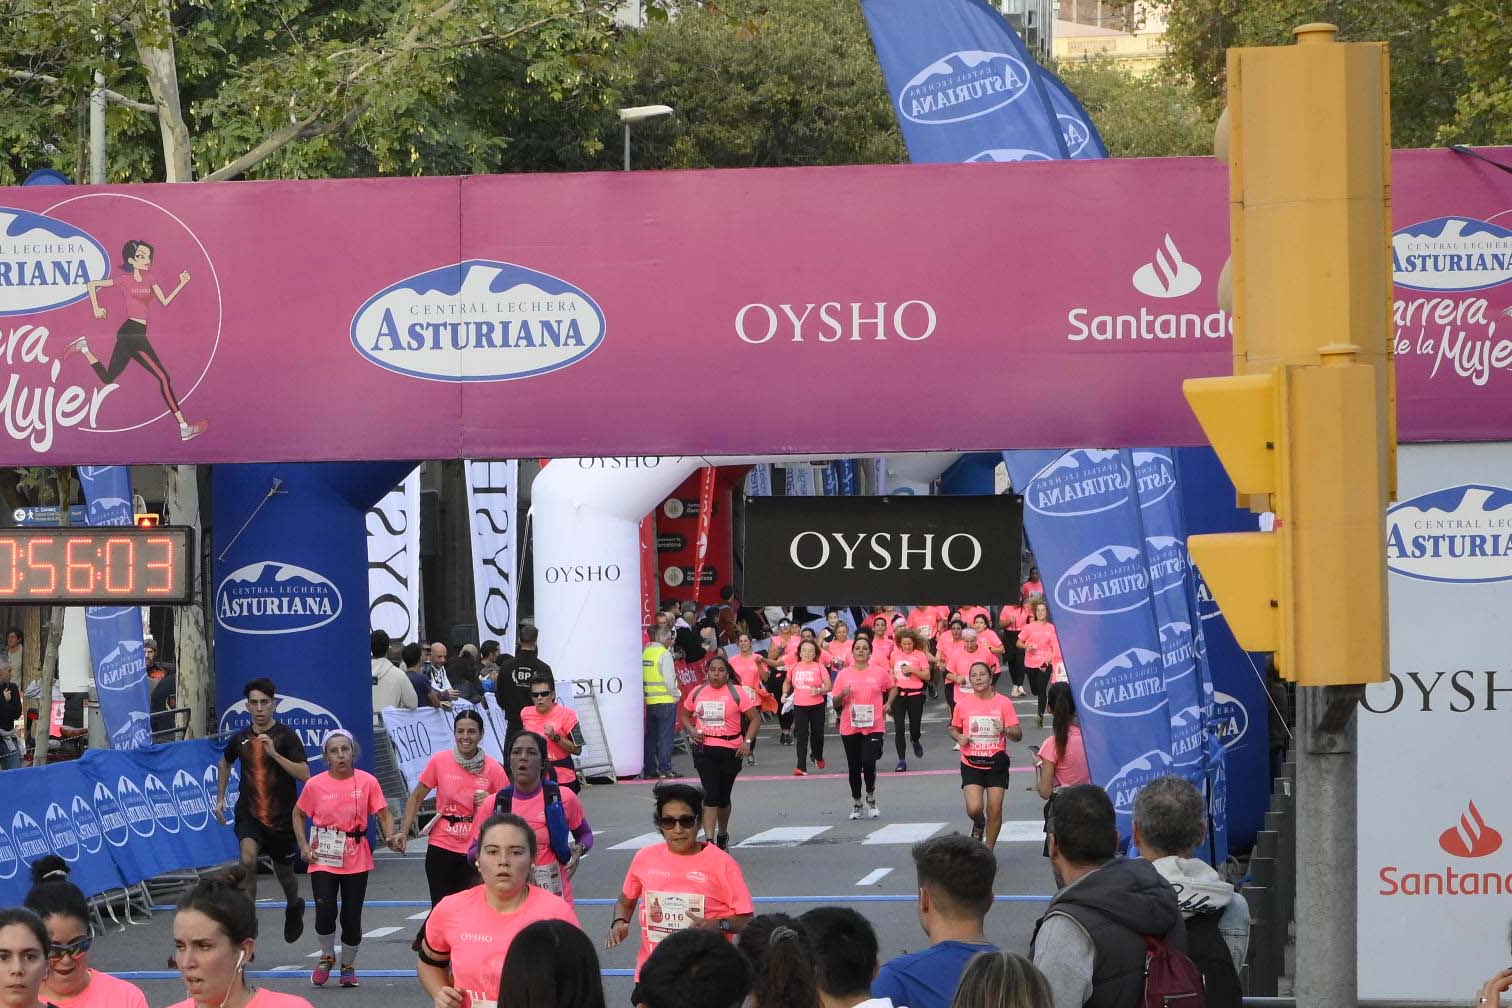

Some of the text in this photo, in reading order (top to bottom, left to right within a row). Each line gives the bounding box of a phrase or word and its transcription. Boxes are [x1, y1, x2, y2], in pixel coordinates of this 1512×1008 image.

[13, 243, 85, 254] LECHERA
[410, 301, 576, 315] CENTRAL LECHERA
[1394, 298, 1488, 326] arrera
[370, 308, 586, 351] ASTURIANA
[735, 300, 937, 344] OYSHO
[1067, 307, 1234, 341] Santand
[1416, 328, 1434, 355] la
[1430, 321, 1512, 386] Muje
[1414, 520, 1481, 529] CENTRAL
[789, 530, 983, 572] OYSHO
[545, 564, 620, 584] OYSHO
[233, 586, 328, 594] CENTRAL LECHERA
[220, 591, 333, 618] ASTURIANA
[1359, 670, 1512, 713] OYSH
[280, 717, 329, 726] LECHERA
